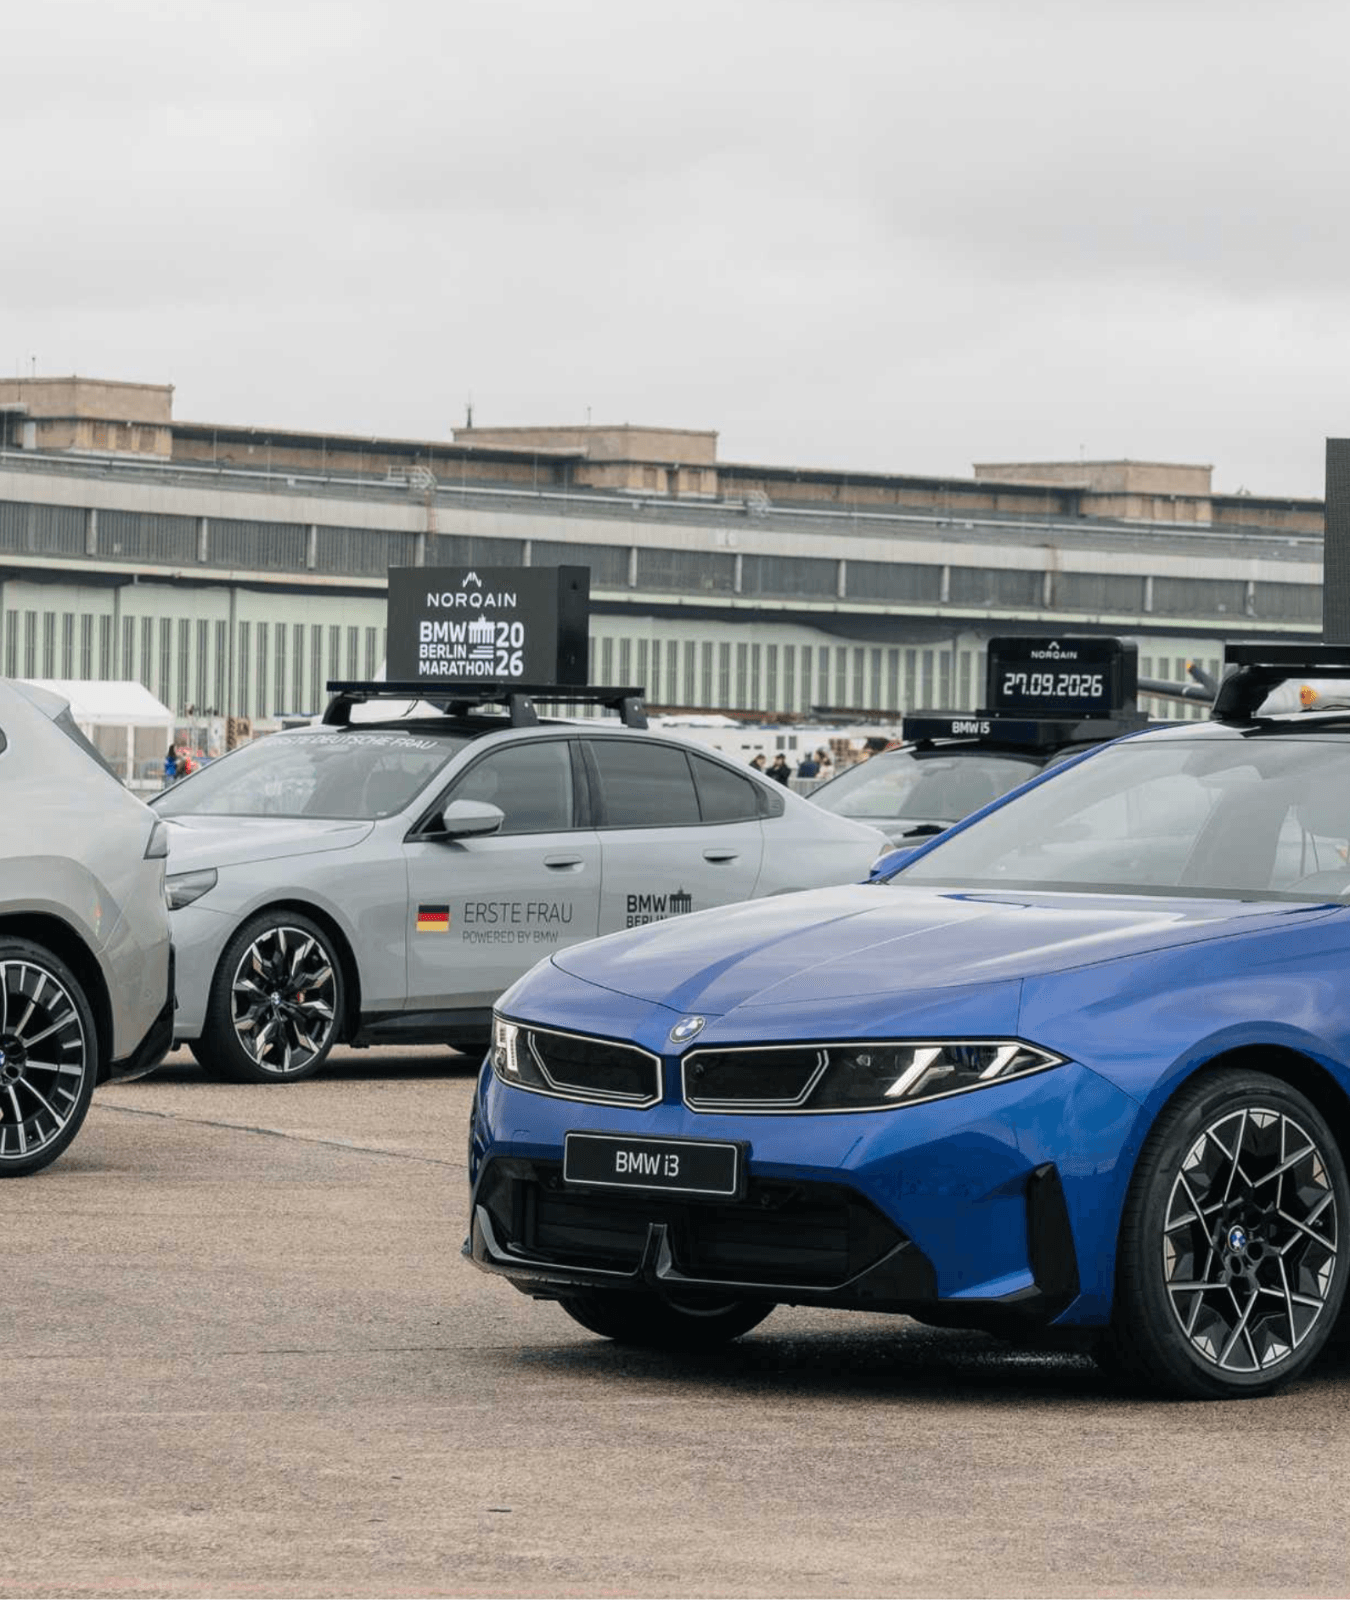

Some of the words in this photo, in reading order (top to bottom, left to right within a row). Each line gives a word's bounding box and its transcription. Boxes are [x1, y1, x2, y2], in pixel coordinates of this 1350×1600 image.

[427, 593, 517, 608] NORQAIN
[419, 621, 467, 643] BMW
[495, 621, 524, 648] 20
[419, 644, 467, 659] BERLIN
[1031, 651, 1078, 660] NORQAIN
[419, 661, 494, 676] MARATHON
[495, 650, 524, 676] 26
[1003, 673, 1103, 697] 27.09.2026
[952, 721, 979, 734] BMW
[464, 902, 522, 923] ERSTE
[526, 902, 573, 923] FRAU
[627, 894, 667, 913] BMW
[462, 931, 515, 944] POWERED
[518, 931, 531, 943] BY
[533, 931, 558, 944] BMW
[616, 1151, 660, 1175] BMW
[664, 1155, 680, 1177] i3
